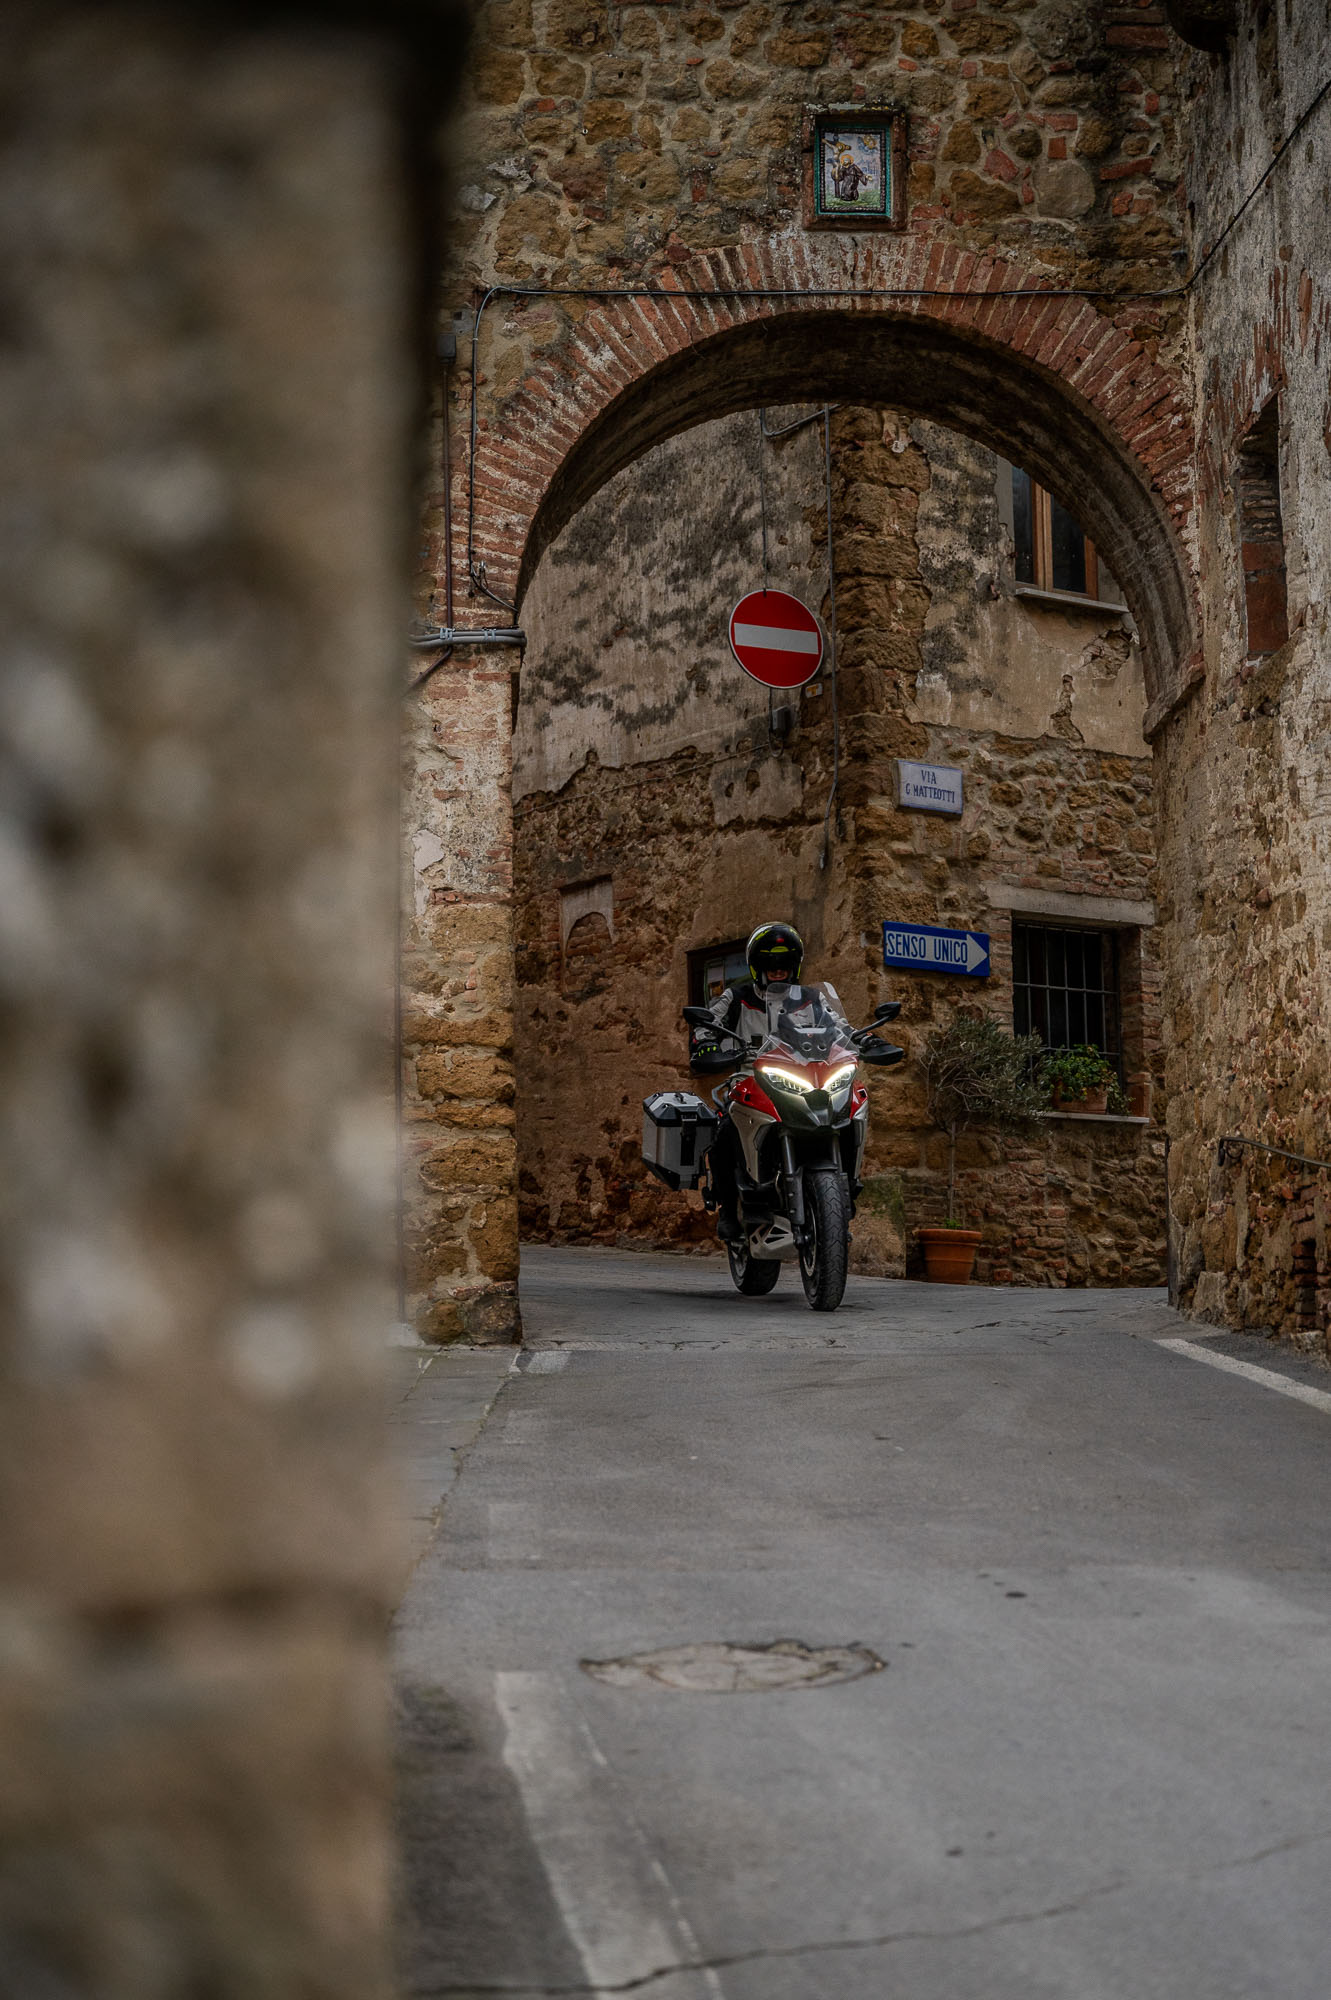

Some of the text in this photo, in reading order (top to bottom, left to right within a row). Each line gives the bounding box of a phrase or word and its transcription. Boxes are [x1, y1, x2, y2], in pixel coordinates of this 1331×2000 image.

[921, 769, 937, 785] VIA
[913, 784, 955, 803] MATTEOTTI
[887, 933, 968, 963] SENSO UNICO
